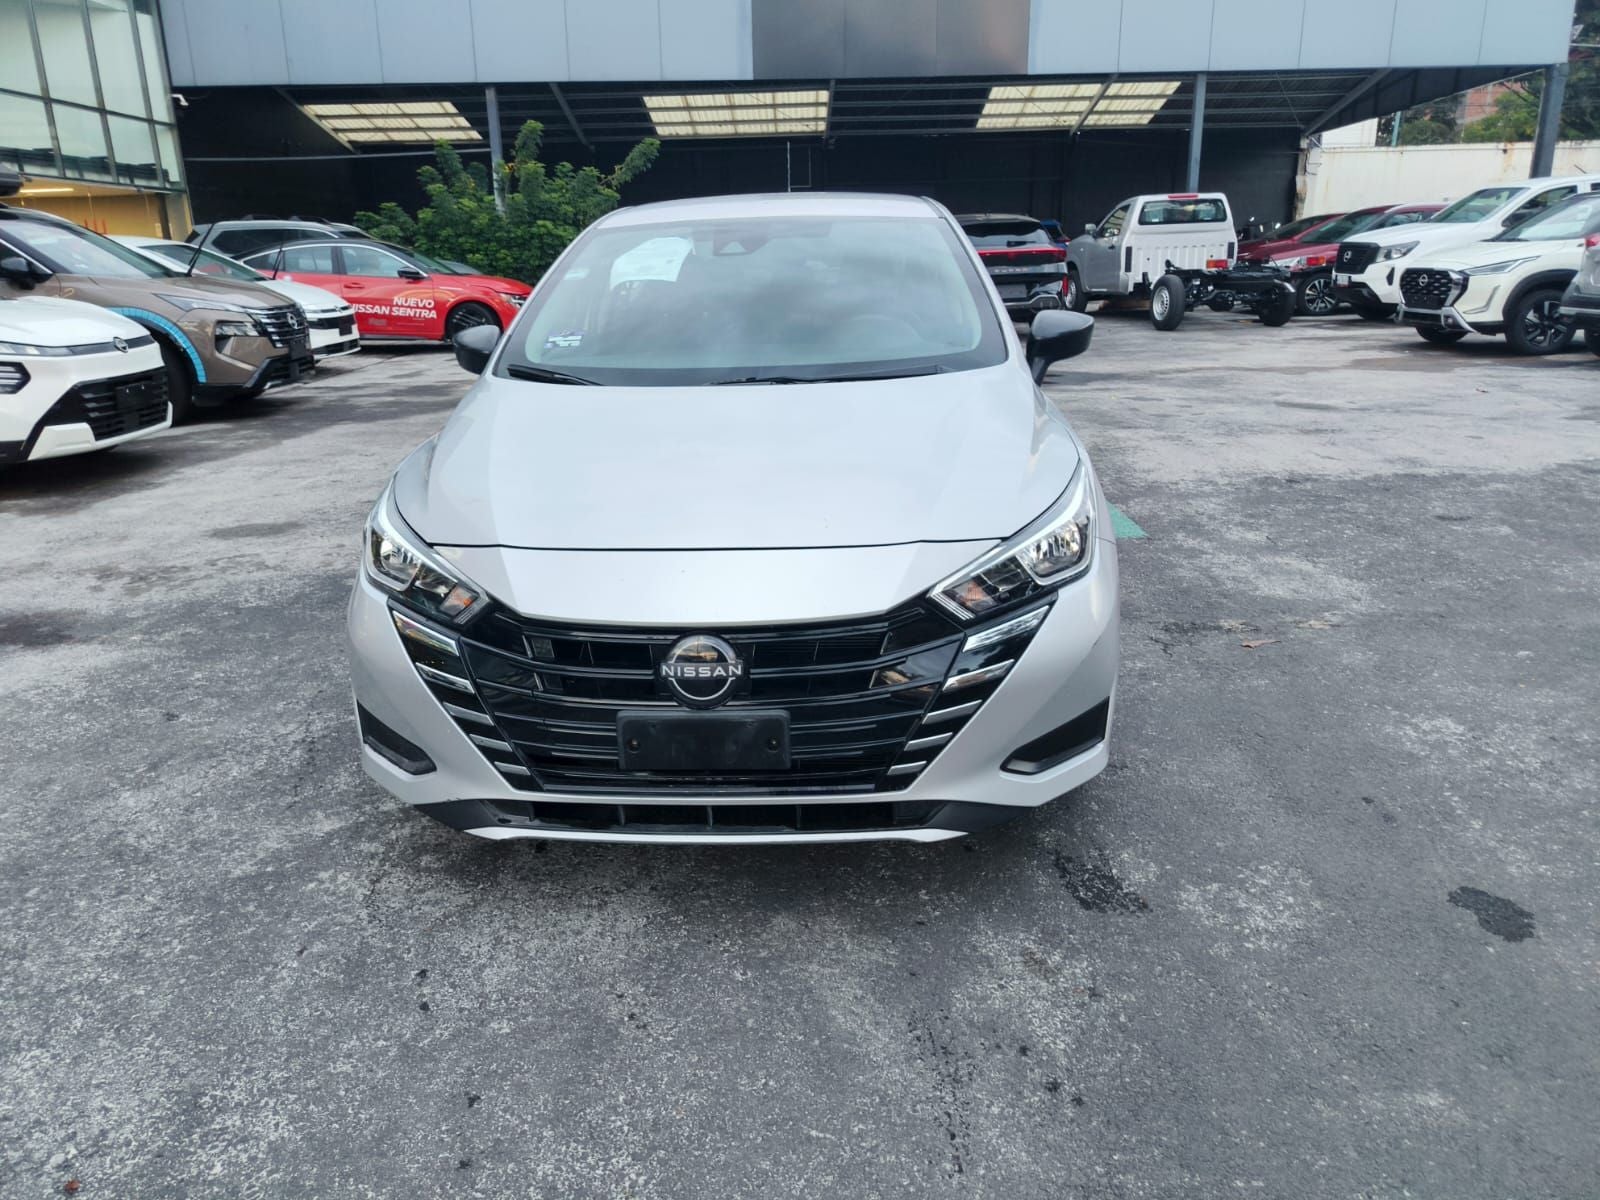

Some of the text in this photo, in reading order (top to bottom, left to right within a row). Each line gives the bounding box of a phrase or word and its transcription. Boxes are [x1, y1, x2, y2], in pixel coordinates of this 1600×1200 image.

[393, 297, 434, 308] NUEVO
[392, 307, 437, 318] SENTRA
[662, 665, 742, 677] NISSAN
